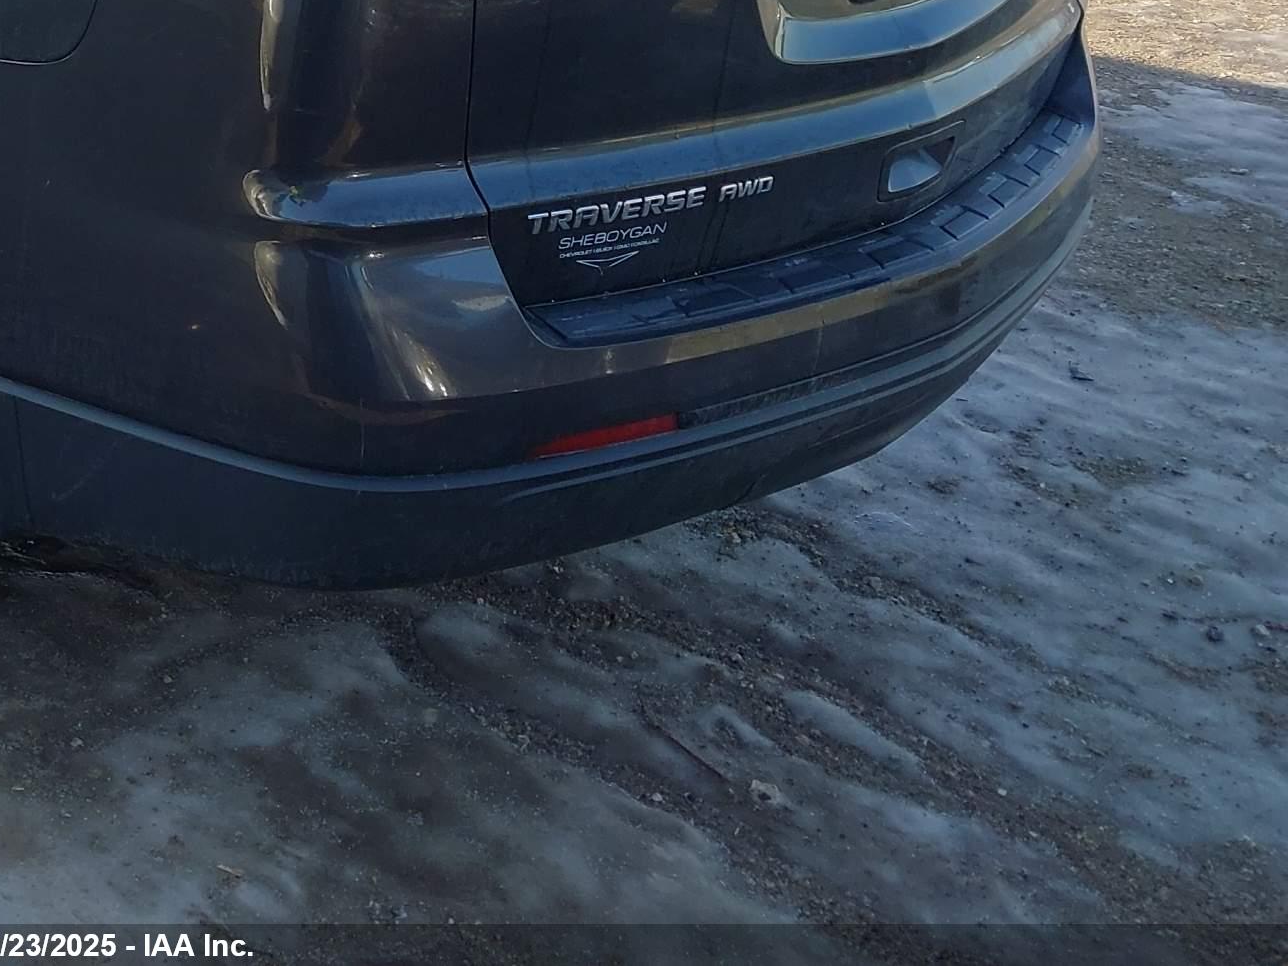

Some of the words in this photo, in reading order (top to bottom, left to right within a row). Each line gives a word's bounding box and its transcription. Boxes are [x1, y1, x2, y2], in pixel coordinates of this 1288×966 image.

[527, 185, 707, 235] TRAVERSE
[718, 175, 774, 203] AWD
[558, 220, 668, 250] SHEBOYGAN
